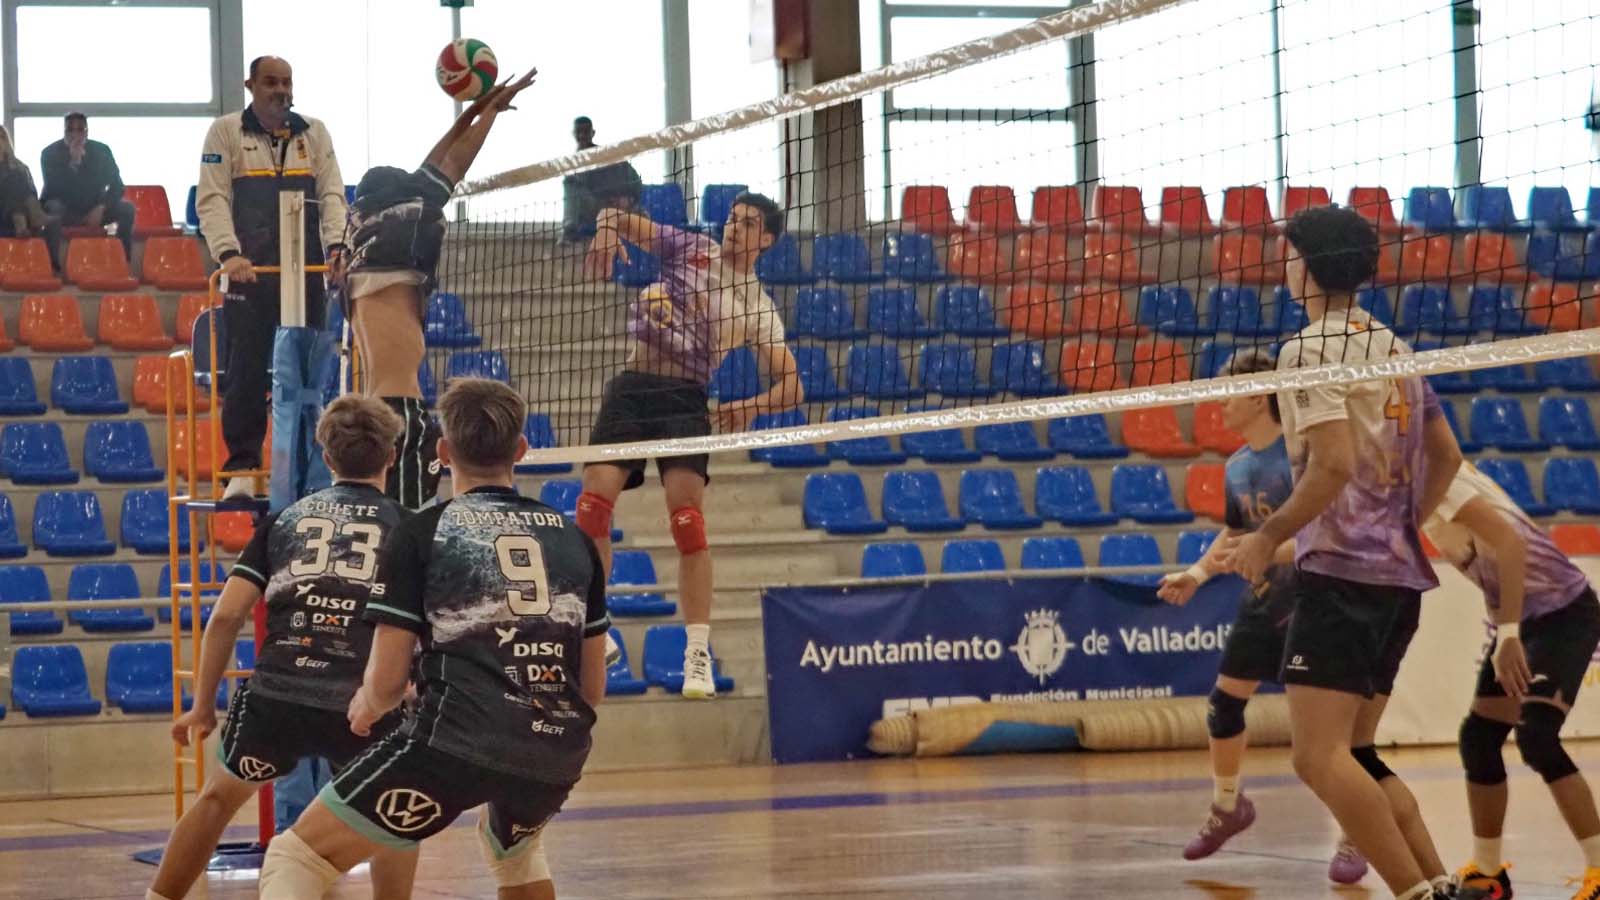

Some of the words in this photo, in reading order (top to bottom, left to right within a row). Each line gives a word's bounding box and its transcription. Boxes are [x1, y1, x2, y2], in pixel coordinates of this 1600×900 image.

[1383, 373, 1412, 437] 4
[304, 500, 379, 518] COHETE
[451, 511, 564, 529] ZOMPATORI
[290, 516, 382, 580] 33
[493, 534, 552, 617] 9
[312, 613, 353, 627] DXT
[799, 634, 1002, 673] Ayuntamiento
[1082, 628, 1109, 655] de
